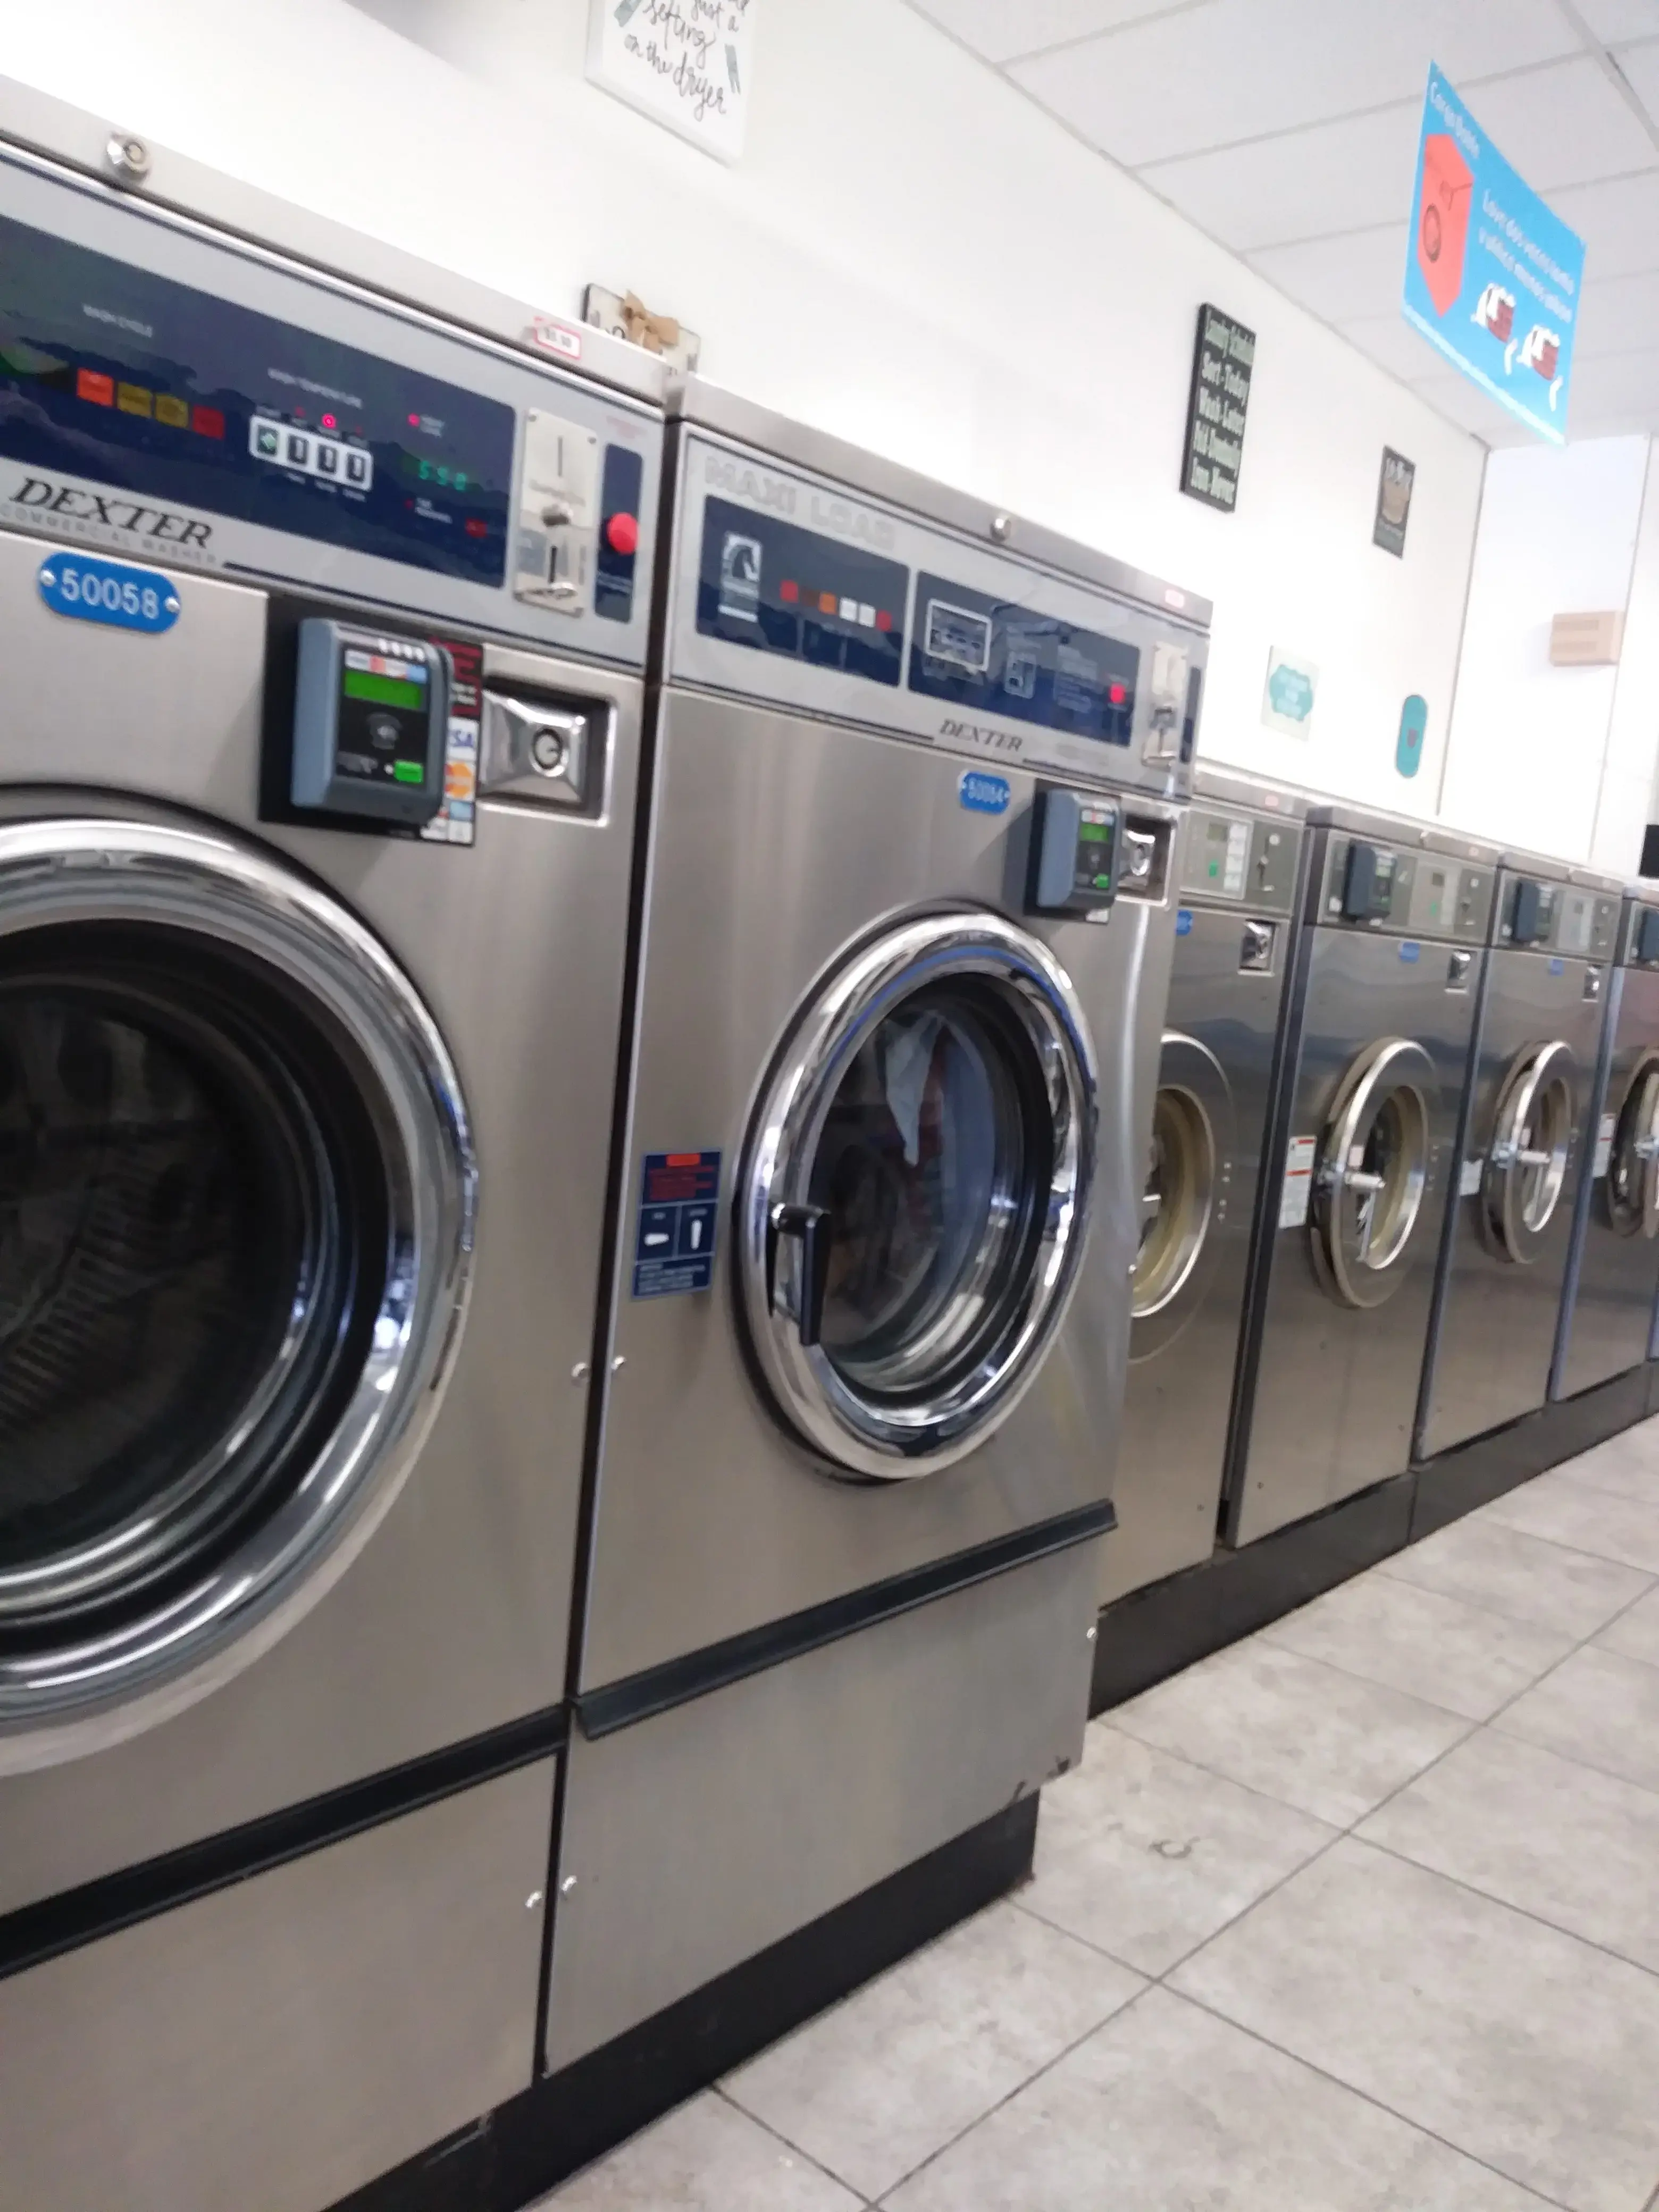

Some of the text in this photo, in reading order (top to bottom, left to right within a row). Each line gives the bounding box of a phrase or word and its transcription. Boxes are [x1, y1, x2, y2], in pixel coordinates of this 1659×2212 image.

[672, 51, 727, 122] dryer
[9, 477, 214, 549] DEXTER
[703, 455, 896, 551] MAXI LOAD
[60, 567, 160, 620] 50058
[939, 718, 1024, 752] DEXTER
